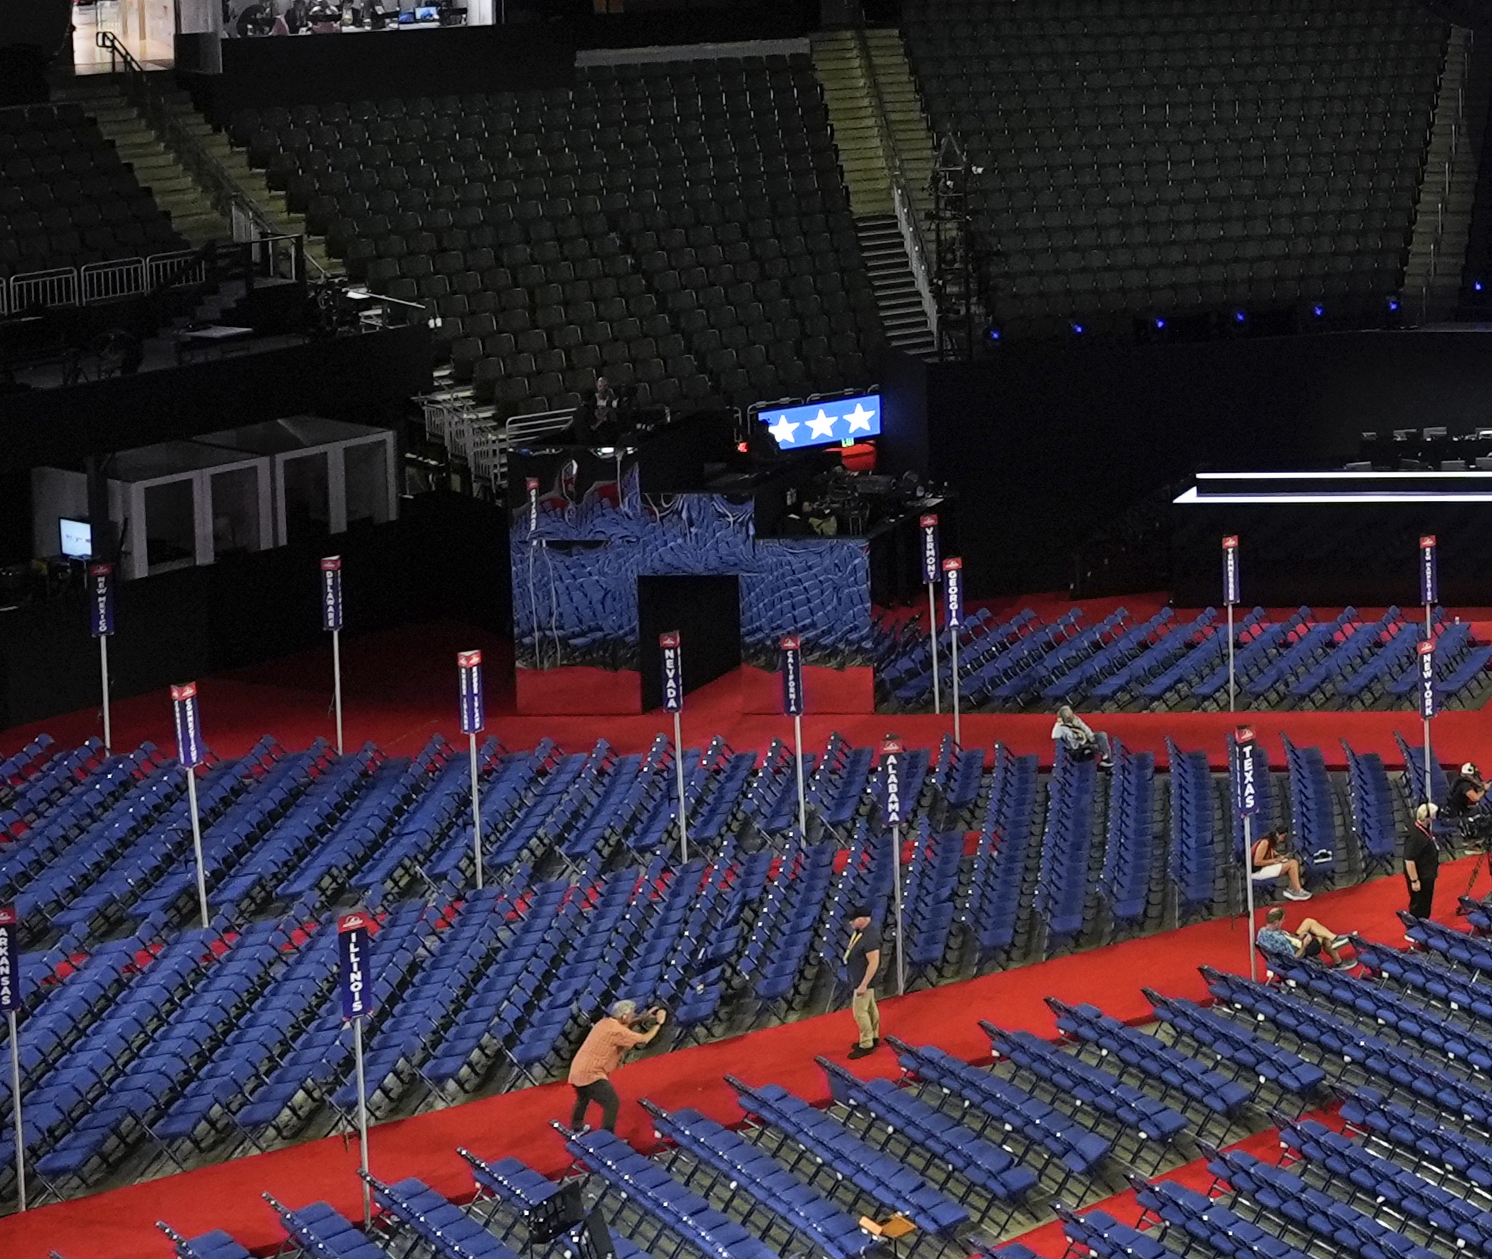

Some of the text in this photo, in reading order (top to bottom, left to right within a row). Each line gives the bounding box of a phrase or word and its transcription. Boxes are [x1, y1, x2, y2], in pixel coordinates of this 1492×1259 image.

[925, 527, 935, 579] VERMONT
[326, 571, 335, 627] DELAWARE
[948, 570, 959, 626] GEORGIA
[665, 649, 677, 708] NEVADA
[787, 650, 797, 712] CALIFORNIA
[1423, 654, 1433, 715] NEW YORK
[886, 754, 900, 821] ALABAMA
[1242, 745, 1255, 809] TEXAS
[0, 927, 11, 1005] ARKANSAS
[349, 931, 363, 1012] ILLINOIS
